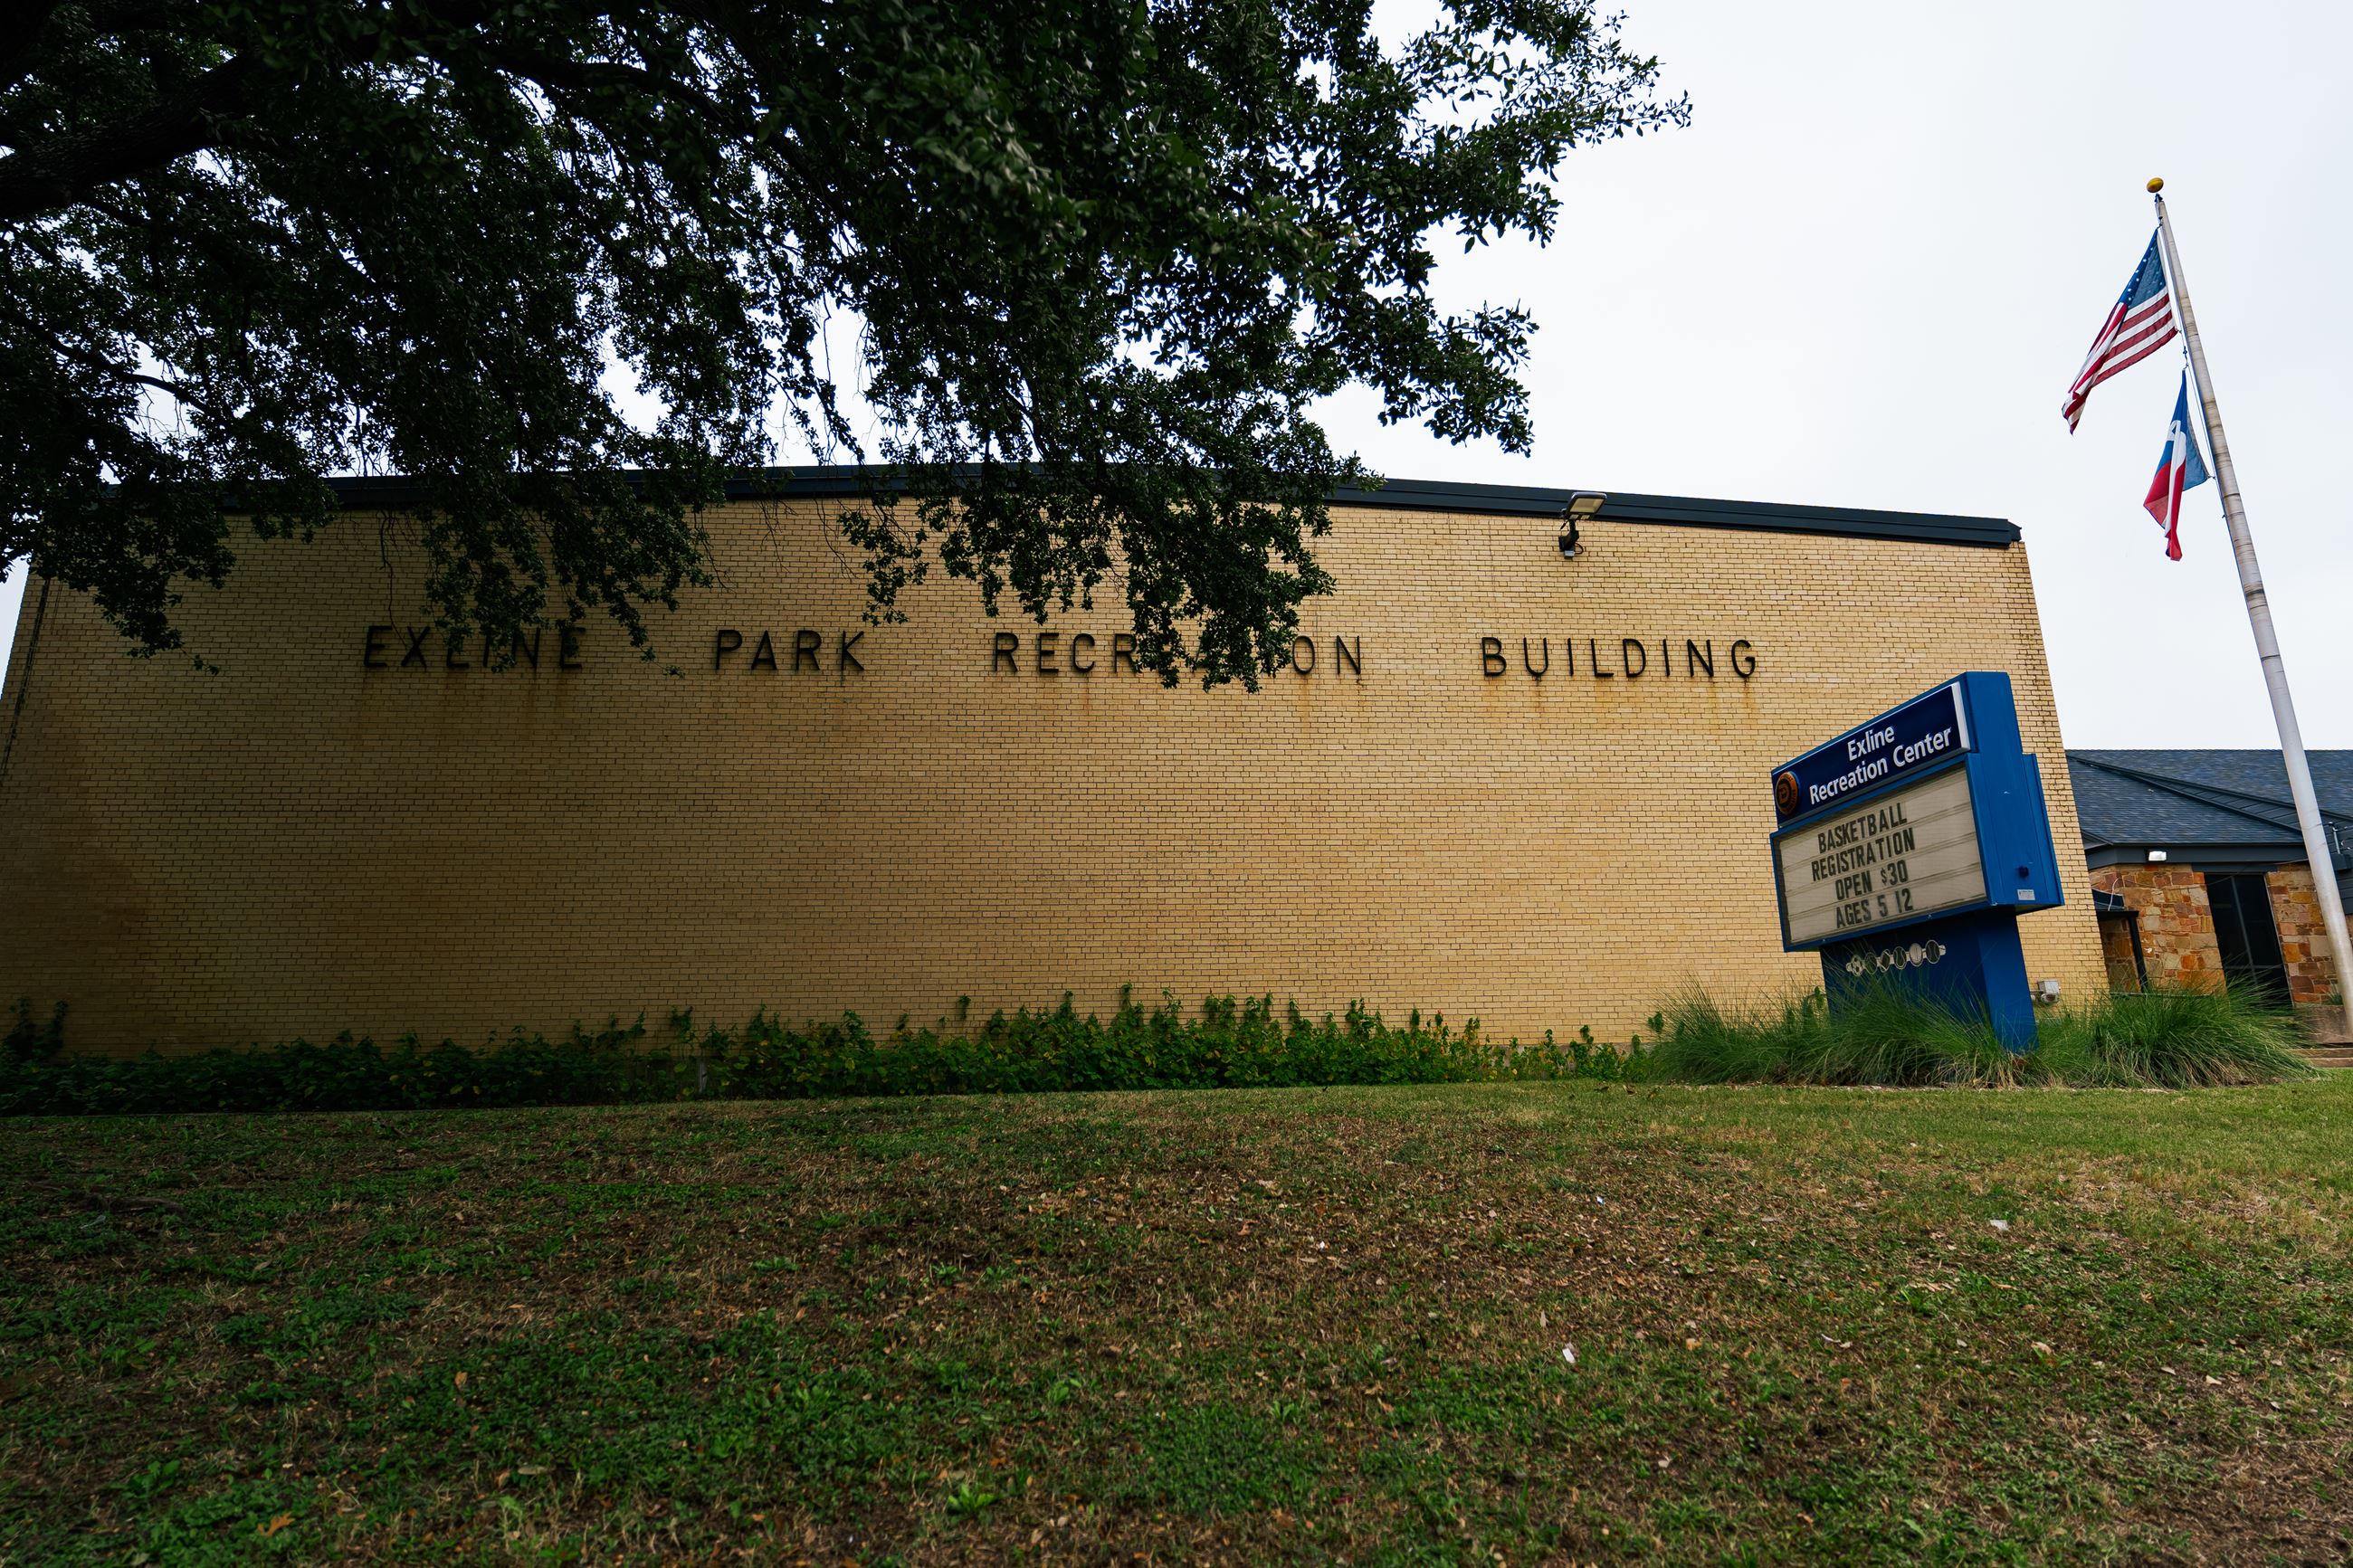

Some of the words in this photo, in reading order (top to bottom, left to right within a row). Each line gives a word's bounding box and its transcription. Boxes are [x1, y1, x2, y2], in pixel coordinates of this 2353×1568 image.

[715, 629, 866, 671] PARK
[995, 632, 1362, 676] RECRON
[1481, 636, 1757, 679] BUILDING
[1809, 757, 1889, 805] Recreation
[1892, 727, 1952, 768] Center
[1847, 726, 1896, 762] Exline
[1817, 803, 1908, 854] BASKETBALL
[1811, 827, 1916, 882] REGISTRATION
[1835, 870, 1873, 901] OPEN
[1881, 860, 1909, 886] $30
[1836, 899, 1872, 929] AGES
[1877, 894, 1889, 917] 5
[1895, 888, 1914, 914] 12
